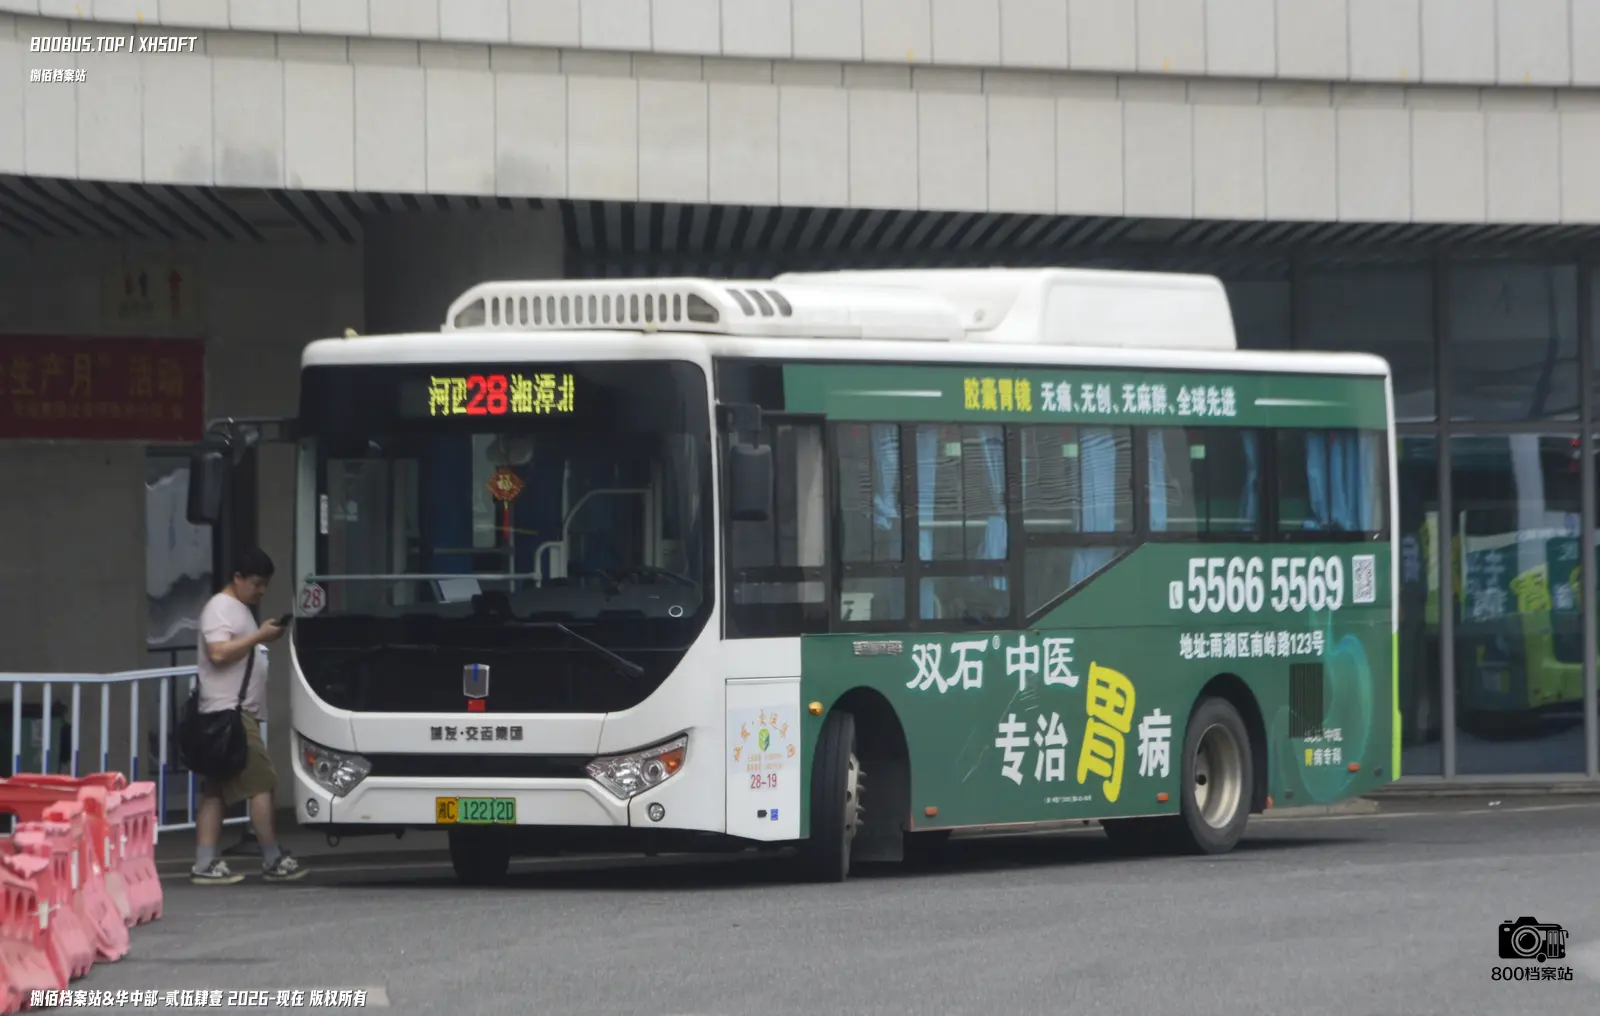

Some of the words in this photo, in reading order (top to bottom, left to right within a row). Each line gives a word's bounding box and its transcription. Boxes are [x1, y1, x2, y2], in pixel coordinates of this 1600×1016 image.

[963, 376, 1032, 412] 胶囊胃镜
[302, 588, 322, 609] 28
[1188, 556, 1265, 613] 5566
[1271, 555, 1344, 612] 5569
[1006, 634, 1080, 692] 中医
[750, 773, 777, 789] 28-19
